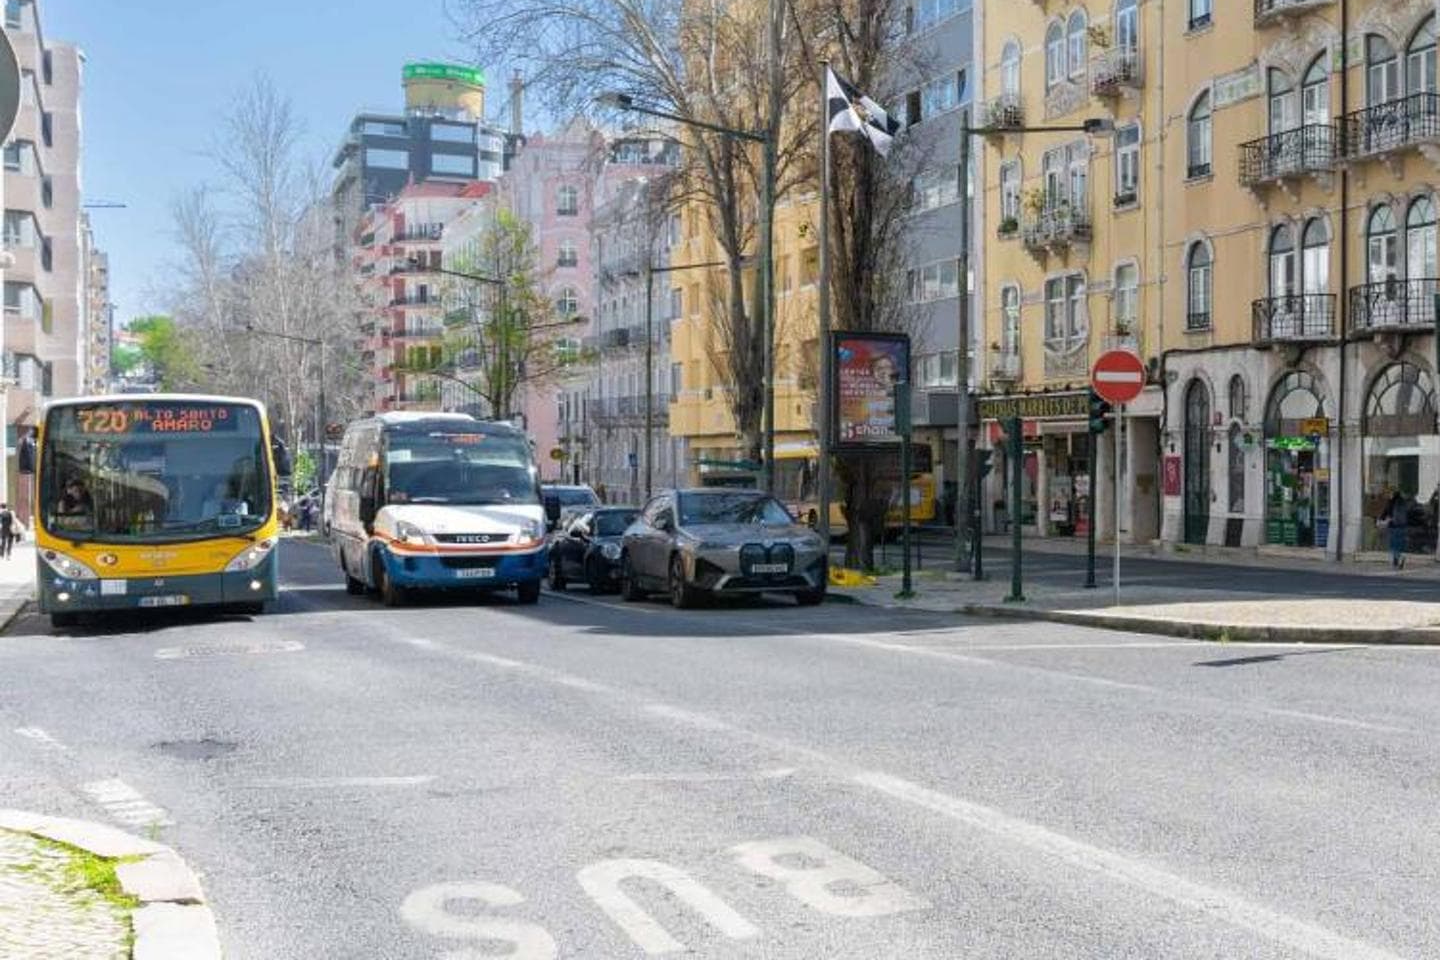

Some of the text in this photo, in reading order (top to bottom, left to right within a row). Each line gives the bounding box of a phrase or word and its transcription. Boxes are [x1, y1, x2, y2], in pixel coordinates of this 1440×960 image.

[78, 410, 128, 432] 720
[152, 419, 213, 432] AMARO
[456, 535, 491, 543] IVECO
[400, 837, 934, 960] BUS
